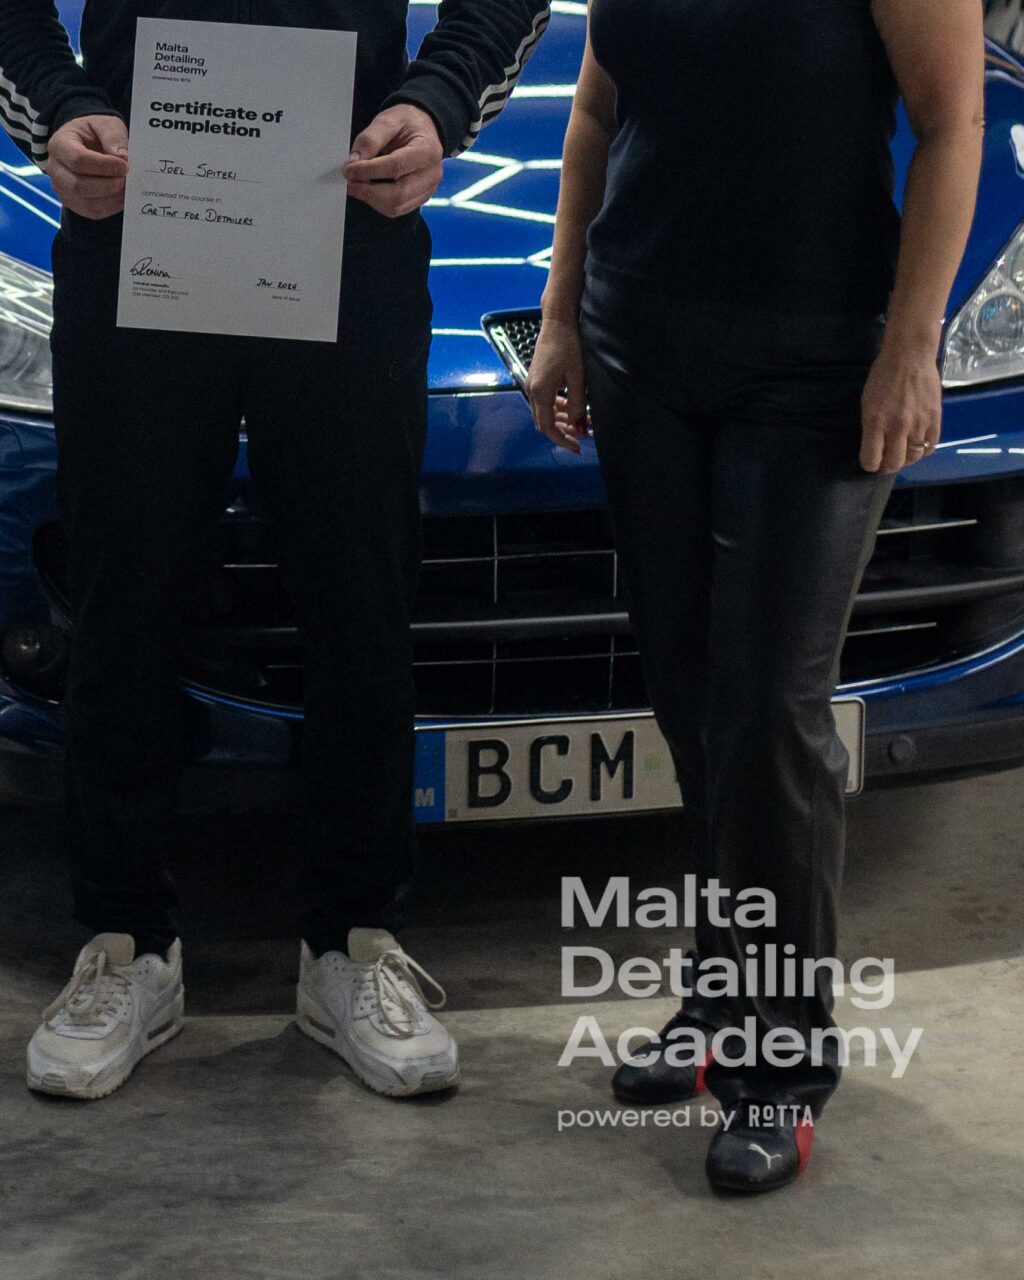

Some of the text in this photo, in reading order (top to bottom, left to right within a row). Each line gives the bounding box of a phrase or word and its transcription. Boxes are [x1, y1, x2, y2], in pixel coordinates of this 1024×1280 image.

[155, 41, 189, 54] Malta
[153, 62, 208, 77] Academy
[154, 52, 206, 67] Detailing
[150, 100, 284, 124] certificate of
[148, 117, 261, 138] completion
[158, 159, 237, 180] JOEL SPITERI
[467, 730, 635, 809] BCM
[414, 787, 435, 808] M
